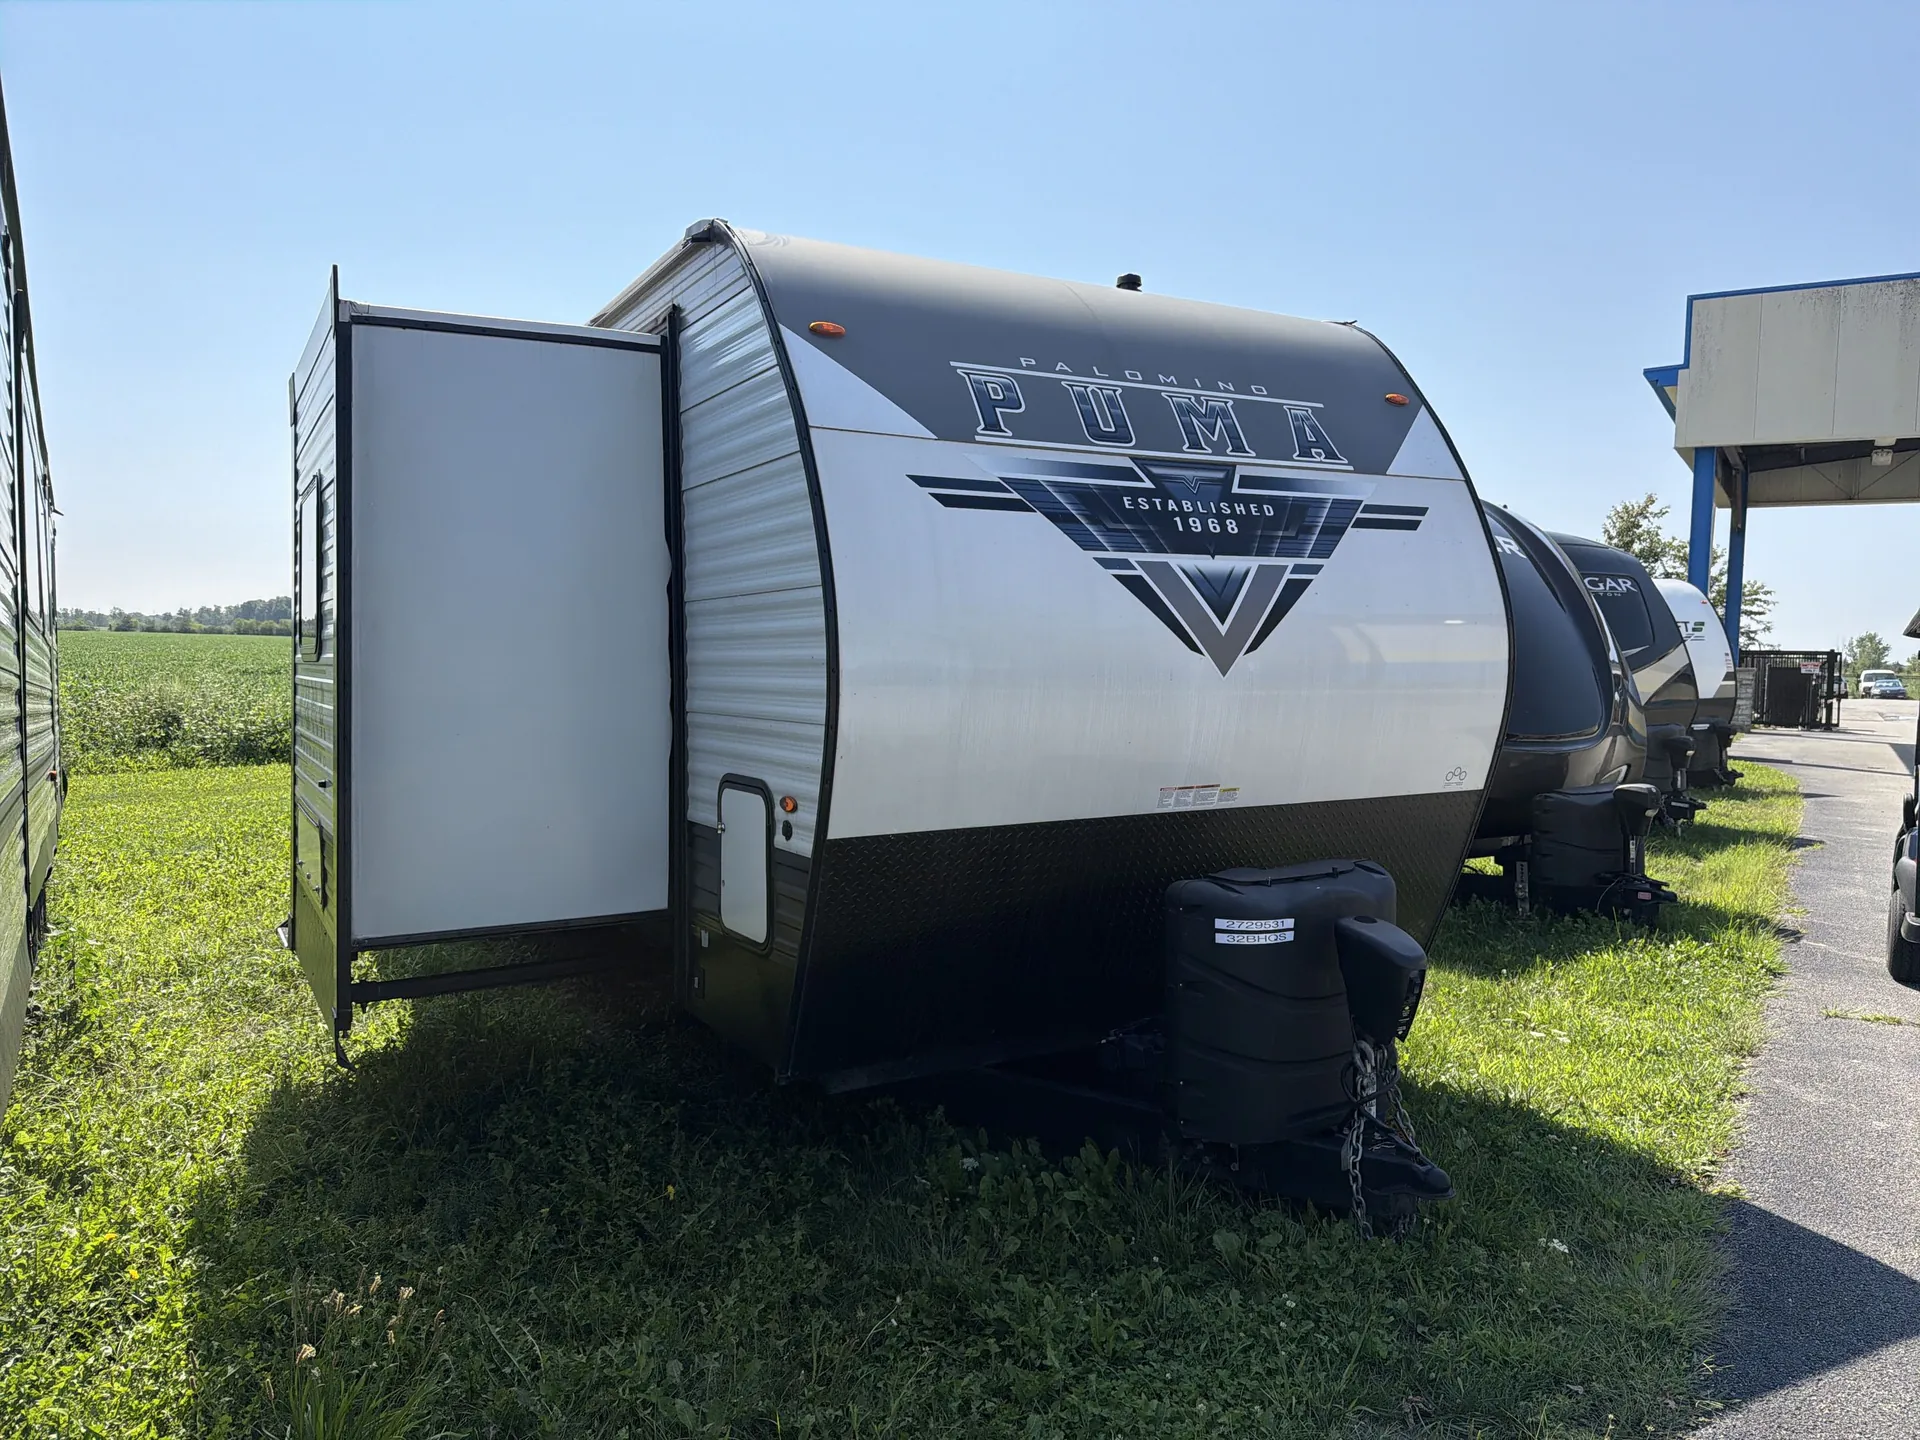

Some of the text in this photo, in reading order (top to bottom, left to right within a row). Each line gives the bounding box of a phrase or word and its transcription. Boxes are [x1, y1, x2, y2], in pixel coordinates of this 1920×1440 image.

[1019, 357, 1268, 395] PALOMINO
[957, 369, 1349, 464] PUMA
[1122, 496, 1275, 516] ESTABLISHED
[1173, 516, 1239, 534] 1968
[1495, 535, 1527, 558] R
[1583, 577, 1638, 592] GAR
[1225, 920, 1285, 929] 2729531
[1226, 933, 1287, 943] 32BHQS
